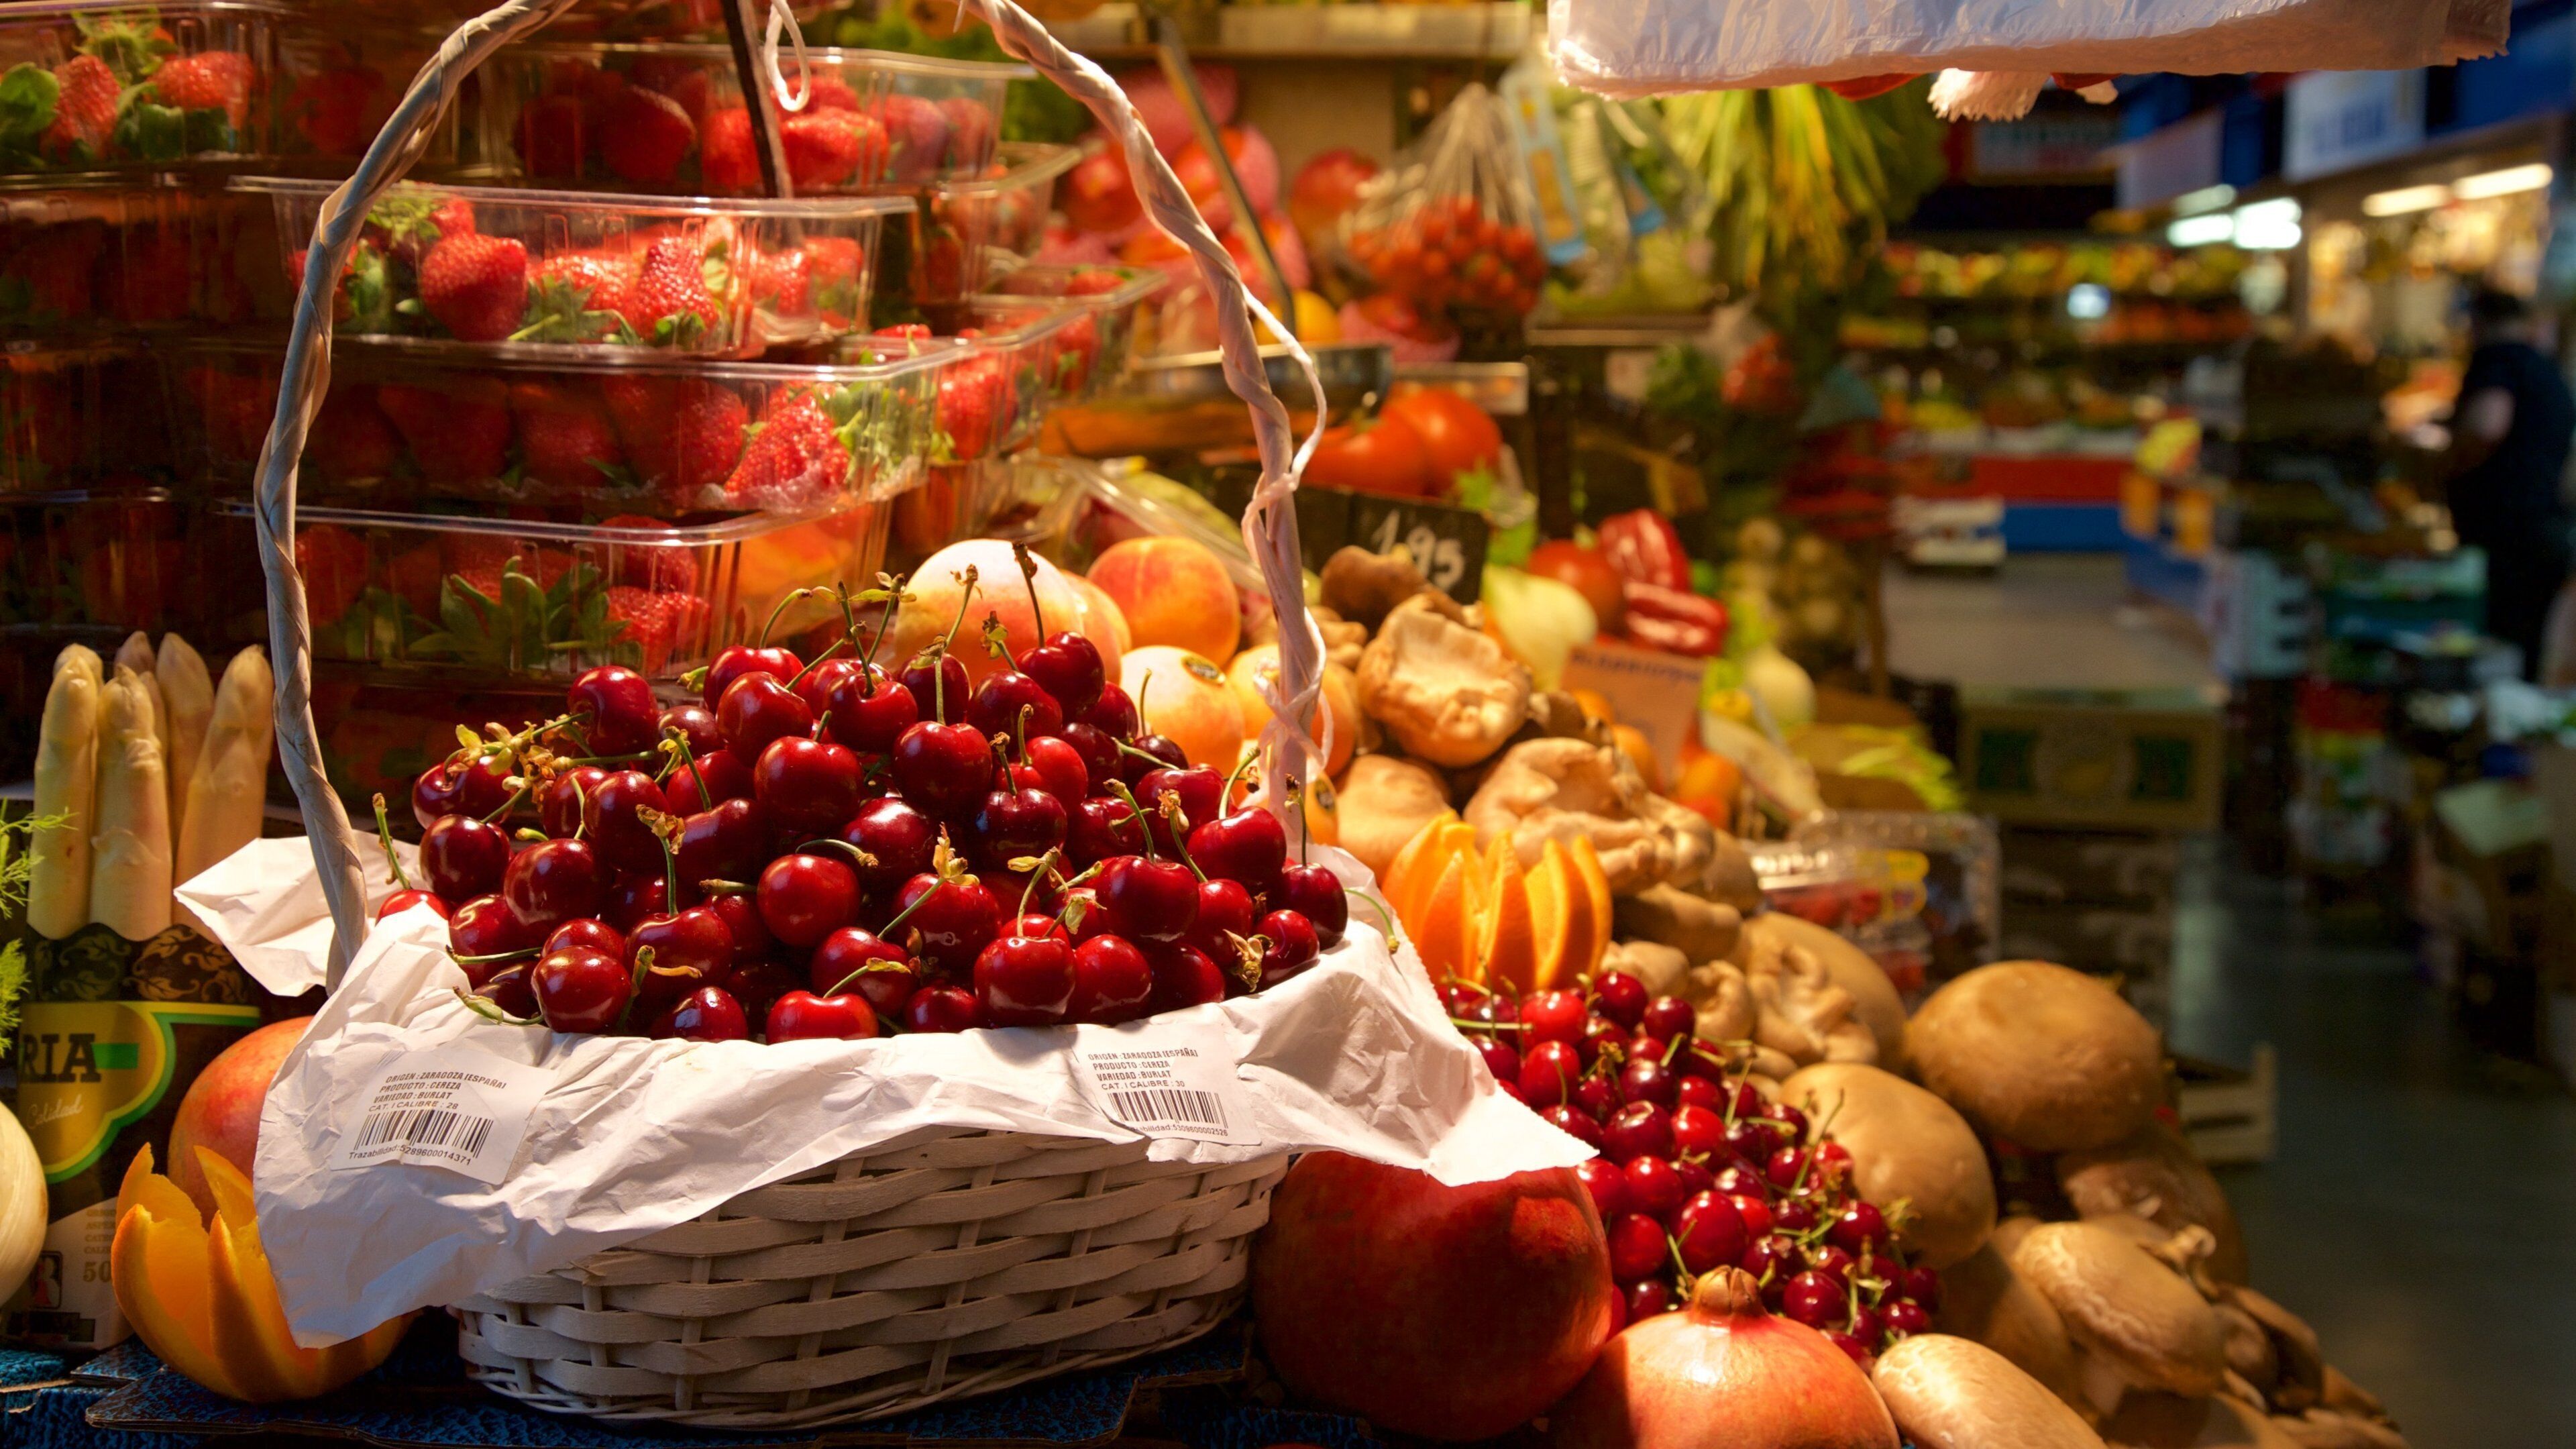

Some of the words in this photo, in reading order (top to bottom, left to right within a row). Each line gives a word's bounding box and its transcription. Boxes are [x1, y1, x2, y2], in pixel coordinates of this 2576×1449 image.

[1088, 1053, 1118, 1061] ORIGEN
[1092, 1061, 1138, 1071] PRODUCTO
[386, 1073, 417, 1083] ORIGEN
[1096, 1071, 1137, 1081] VARIEDAD
[379, 1081, 424, 1093] PRODUCTO
[1101, 1082, 1124, 1090] CAT.
[1129, 1079, 1169, 1089] CALIBRE
[373, 1091, 414, 1104] VARIEDAD
[368, 1104, 389, 1112] CAT.
[396, 1100, 439, 1108] CALIBRE
